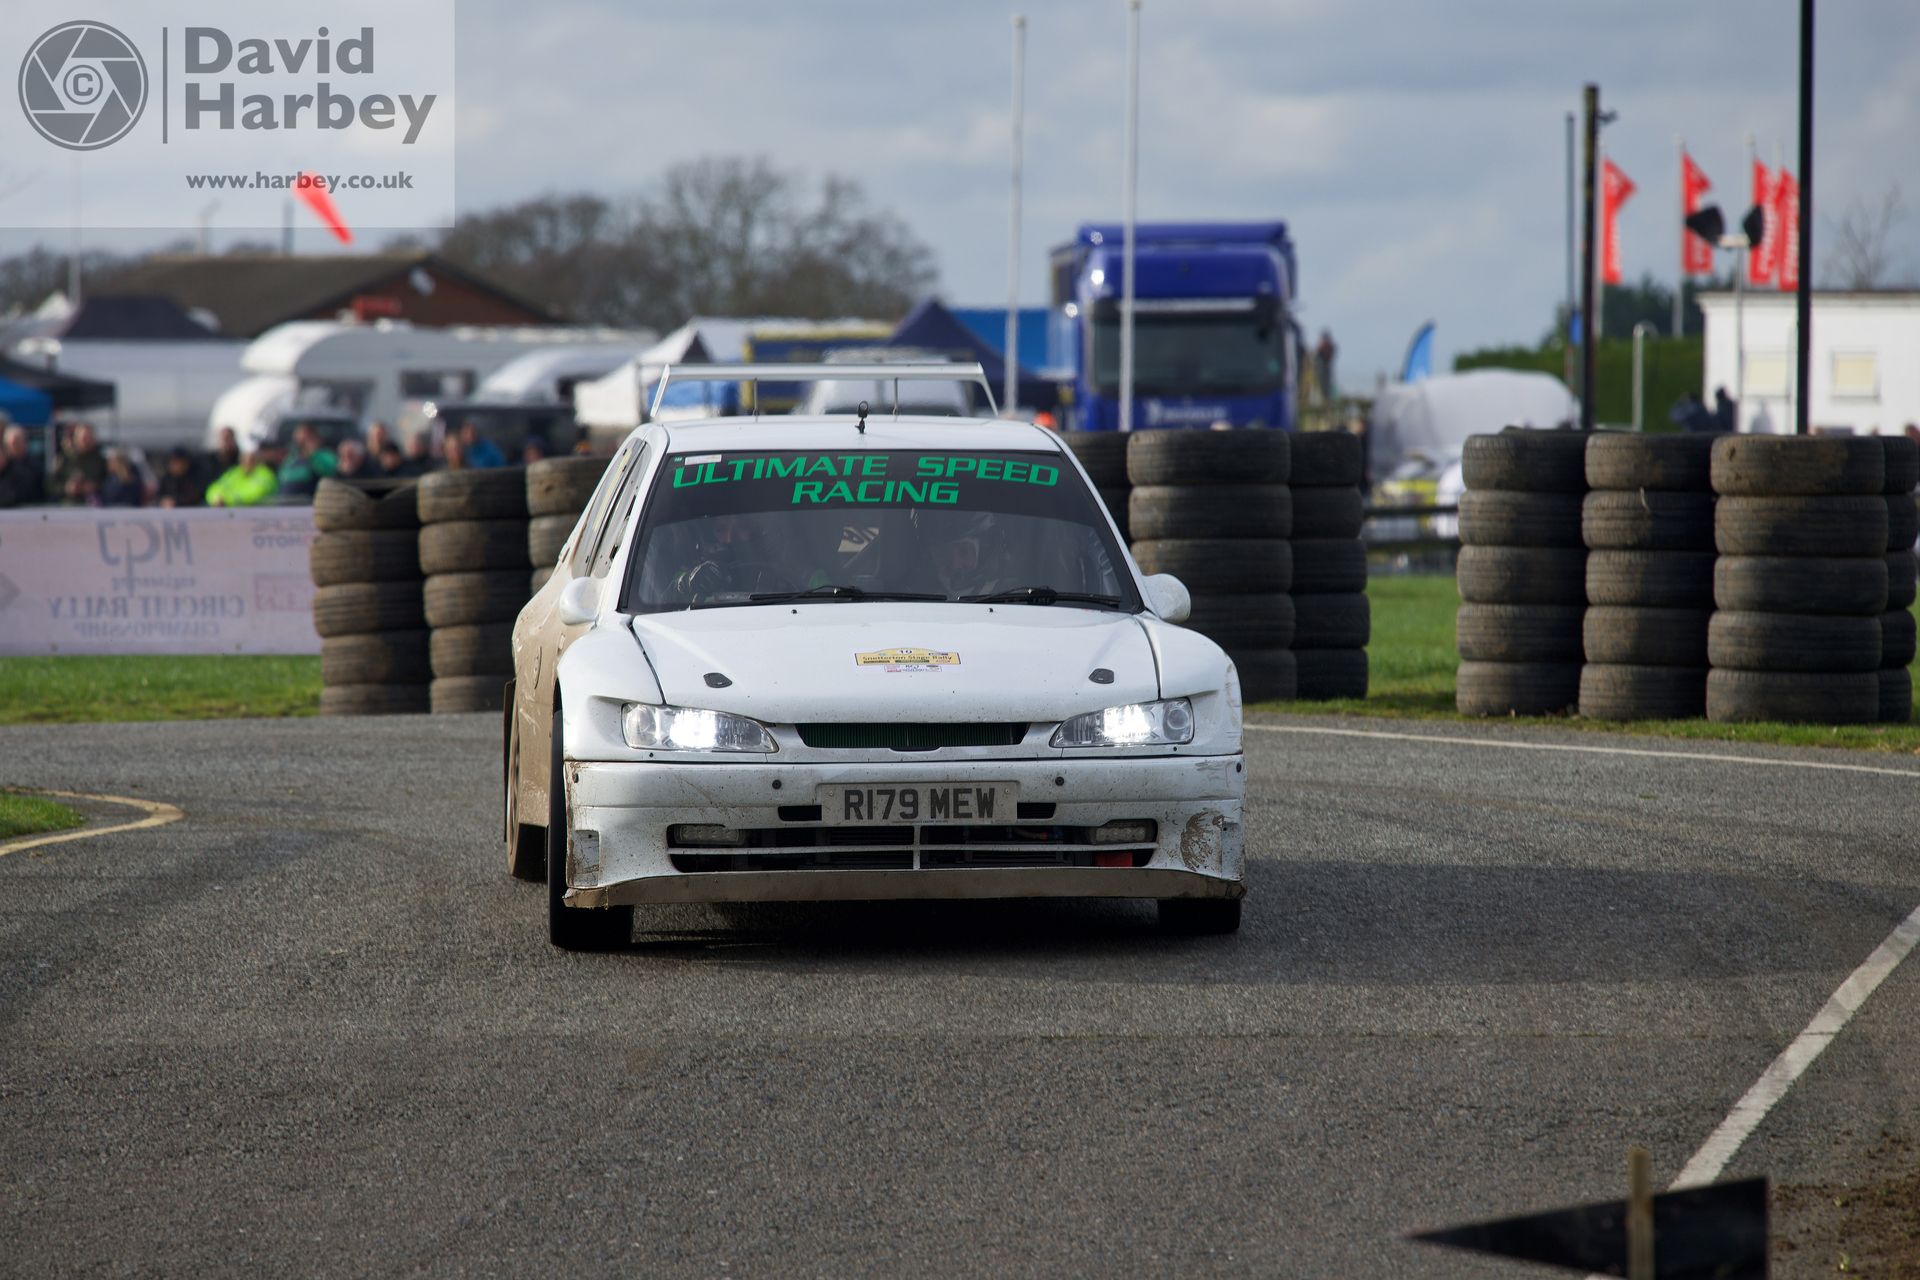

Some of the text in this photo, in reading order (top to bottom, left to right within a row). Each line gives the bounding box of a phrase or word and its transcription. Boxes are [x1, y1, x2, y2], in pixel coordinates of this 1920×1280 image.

[673, 456, 1060, 489] ULTIMATE SPEED
[791, 480, 959, 505] RACING
[844, 787, 996, 820] R179 MEW
